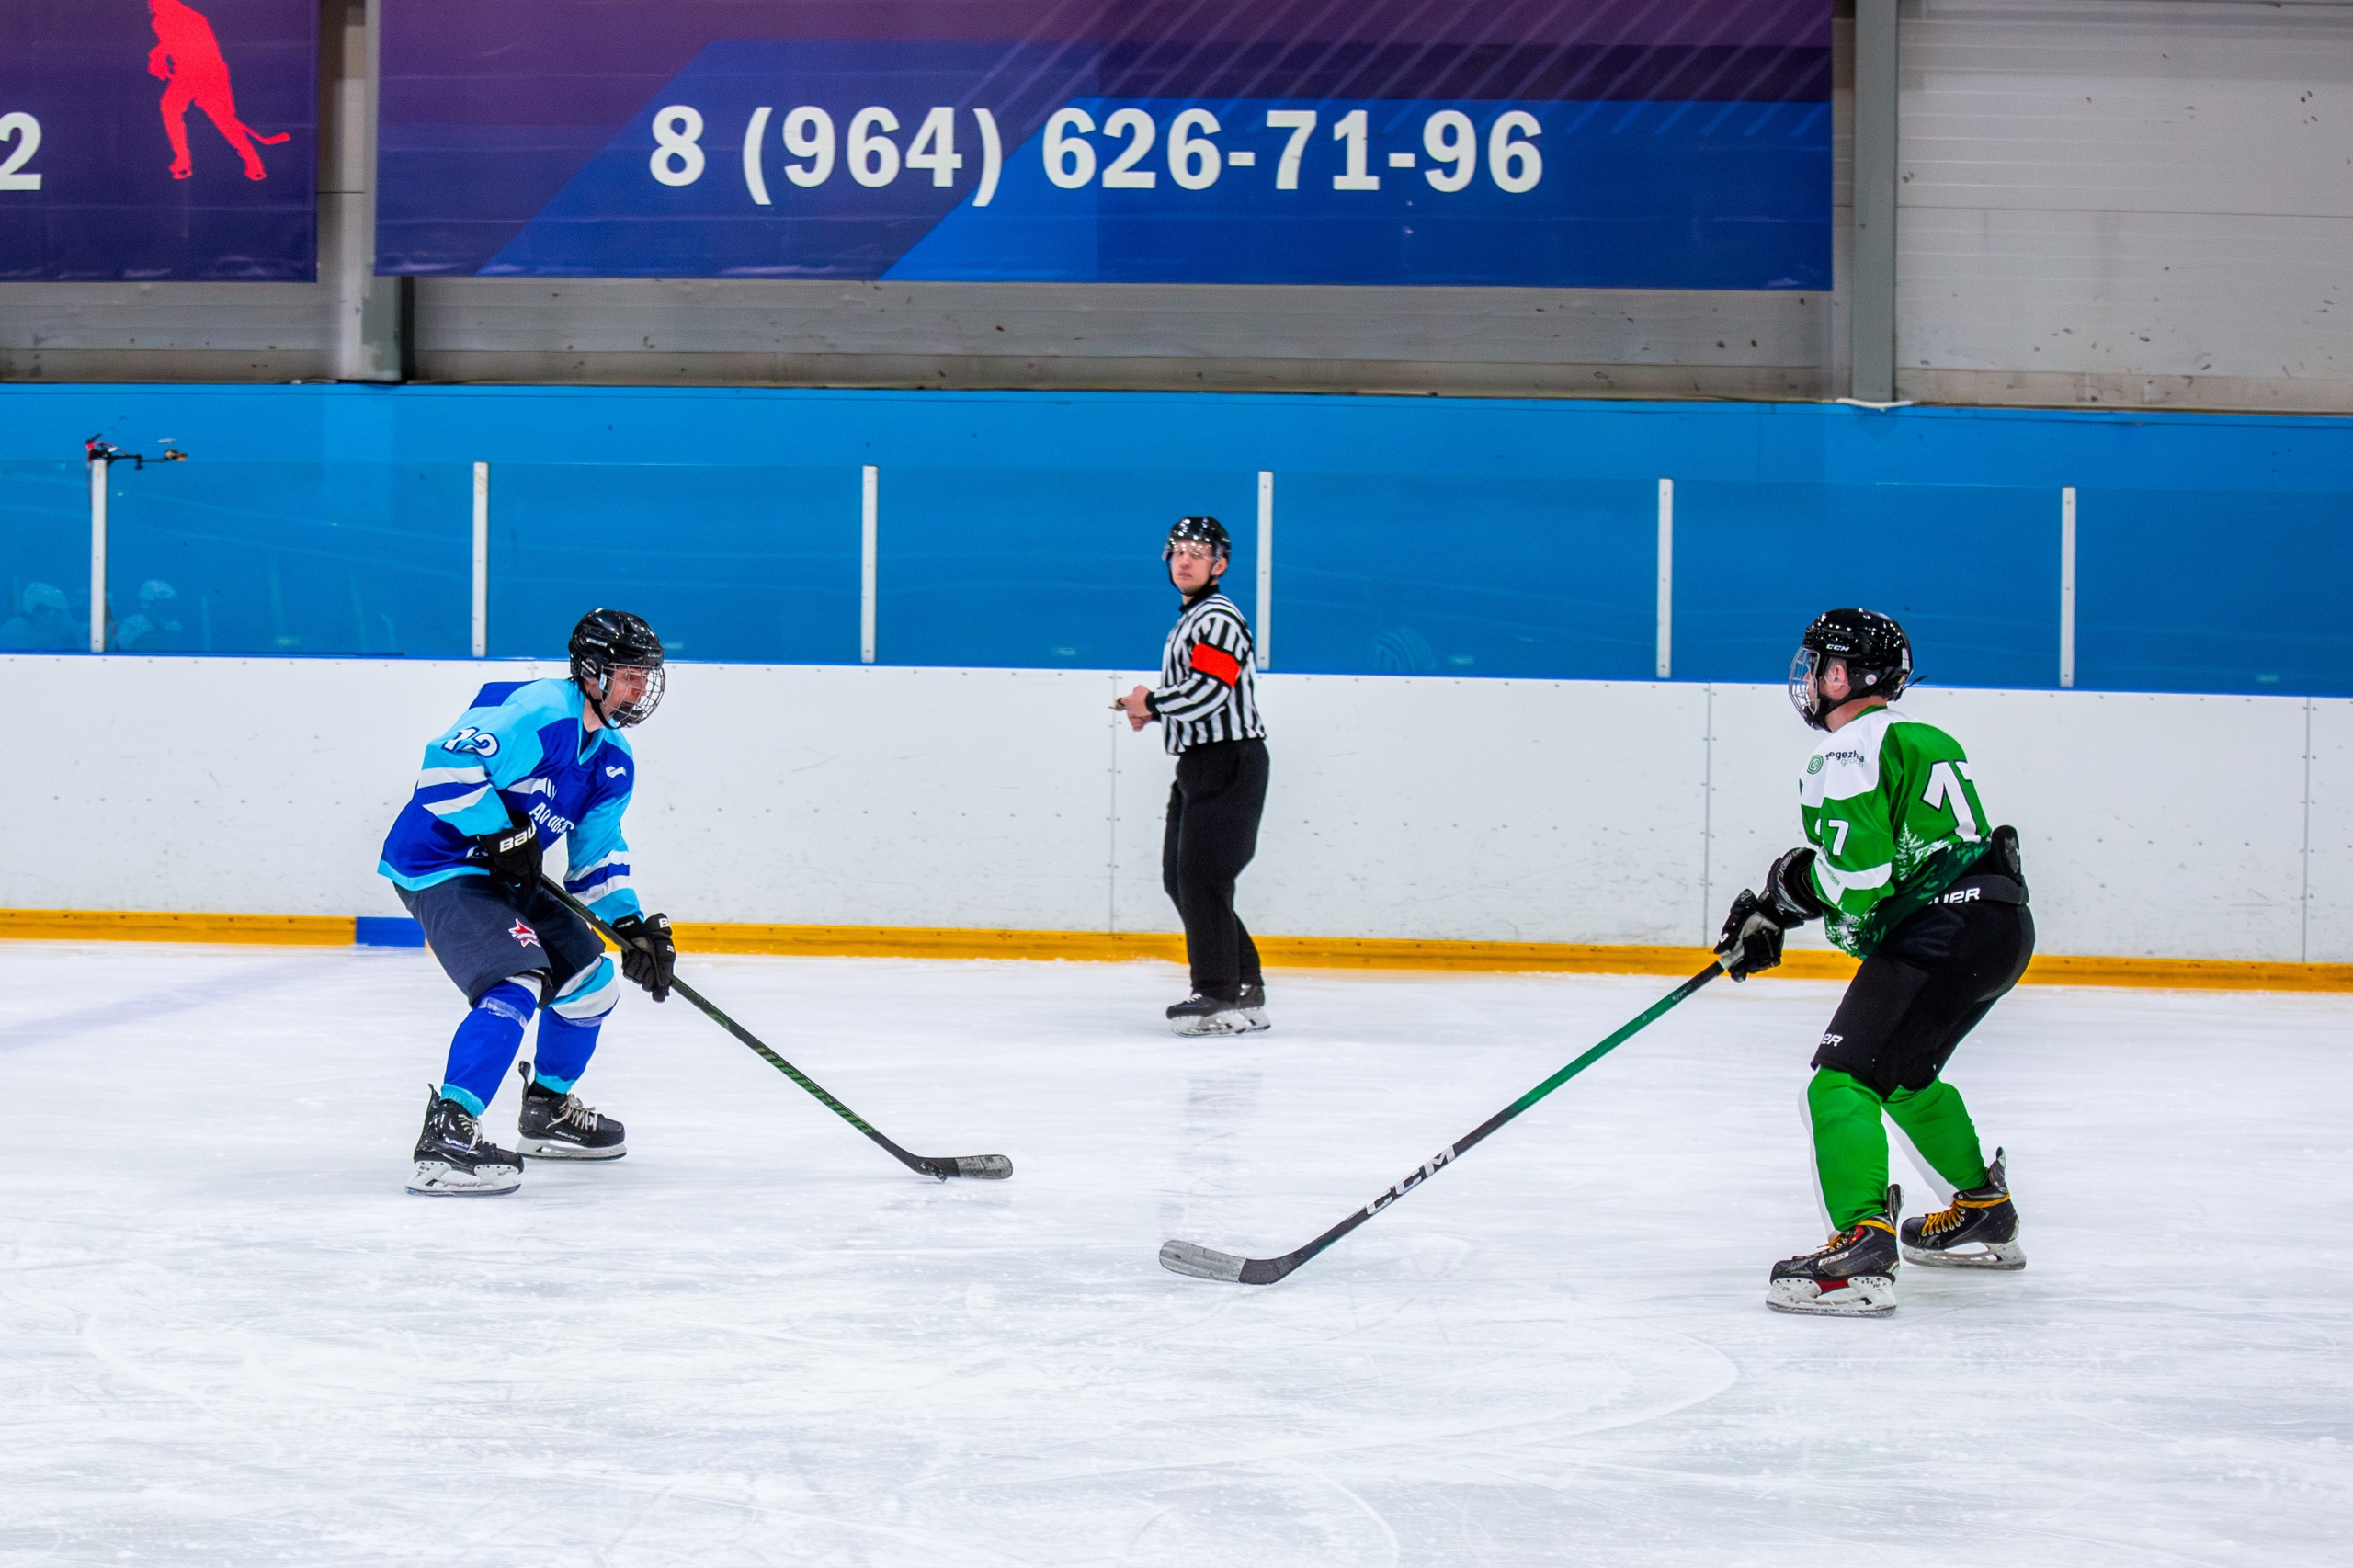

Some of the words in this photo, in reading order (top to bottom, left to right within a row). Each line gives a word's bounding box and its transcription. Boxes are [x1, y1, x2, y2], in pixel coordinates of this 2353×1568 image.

[0, 111, 42, 191] 2
[649, 104, 706, 187] 8
[743, 105, 1003, 207] (964)
[1042, 108, 1543, 193] 626-71-96
[1825, 643, 1850, 653] CCM
[1825, 749, 1865, 763] segezha
[1928, 886, 1981, 905] UER
[554, 1130, 582, 1142] BAUER
[1365, 1144, 1457, 1216] CCM
